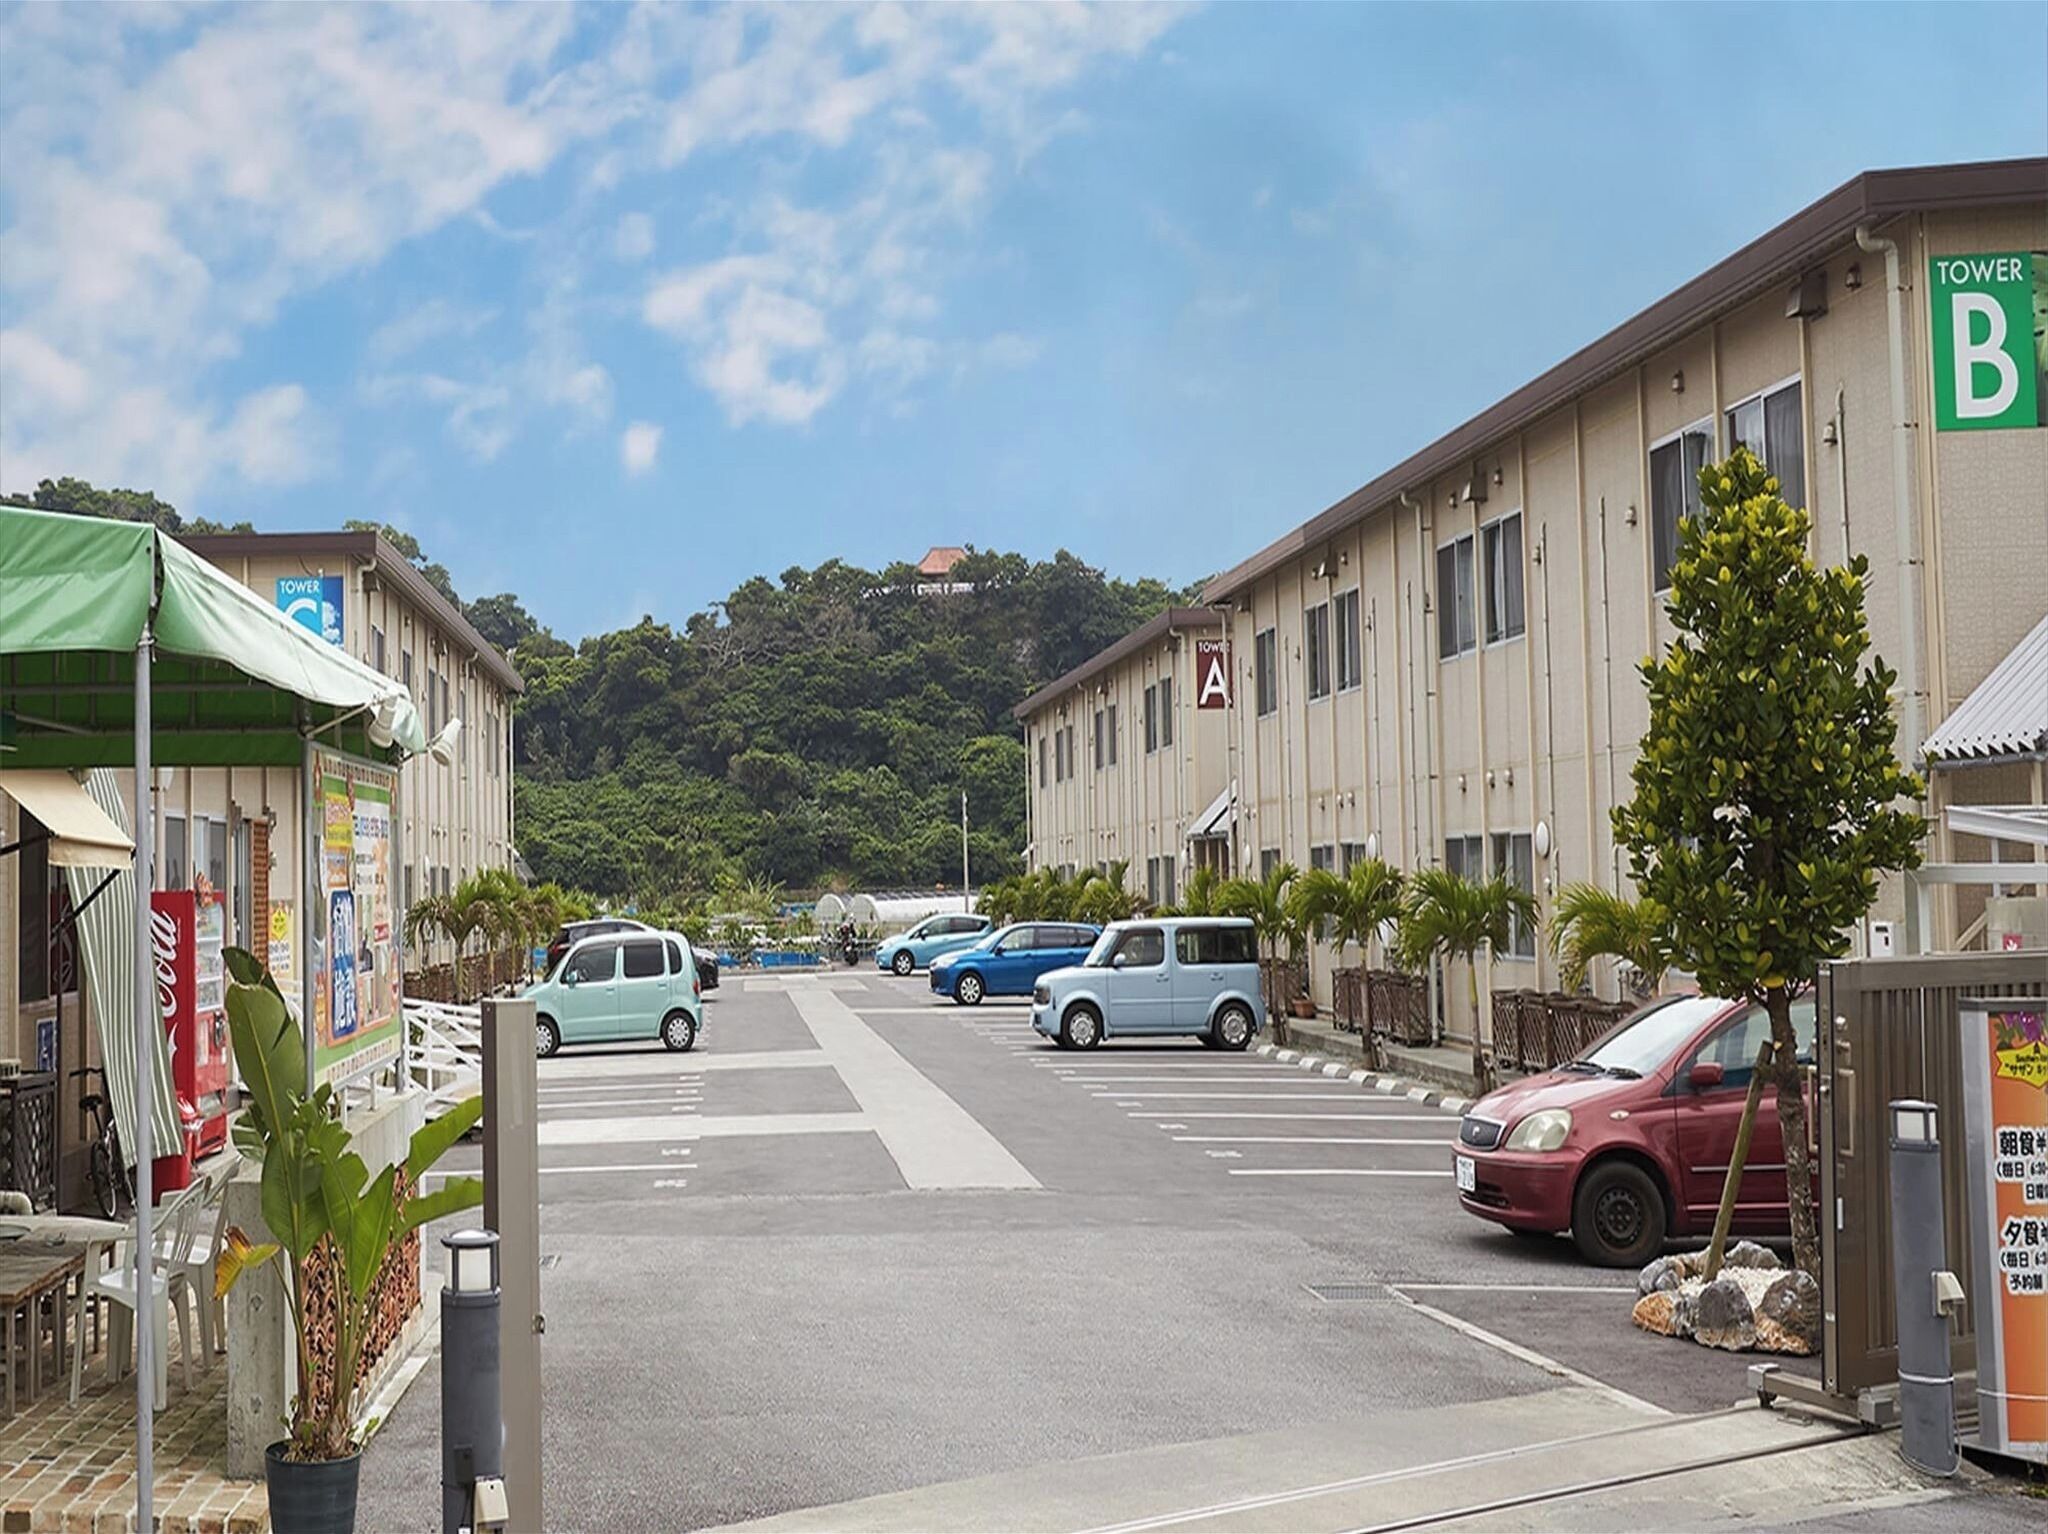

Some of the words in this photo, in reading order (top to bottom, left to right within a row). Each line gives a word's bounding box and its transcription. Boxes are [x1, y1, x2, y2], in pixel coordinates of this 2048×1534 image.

[1937, 258, 2023, 285] TOWER
[1952, 292, 2019, 418] B
[280, 580, 320, 595] TOWER
[1199, 656, 1232, 705] A
